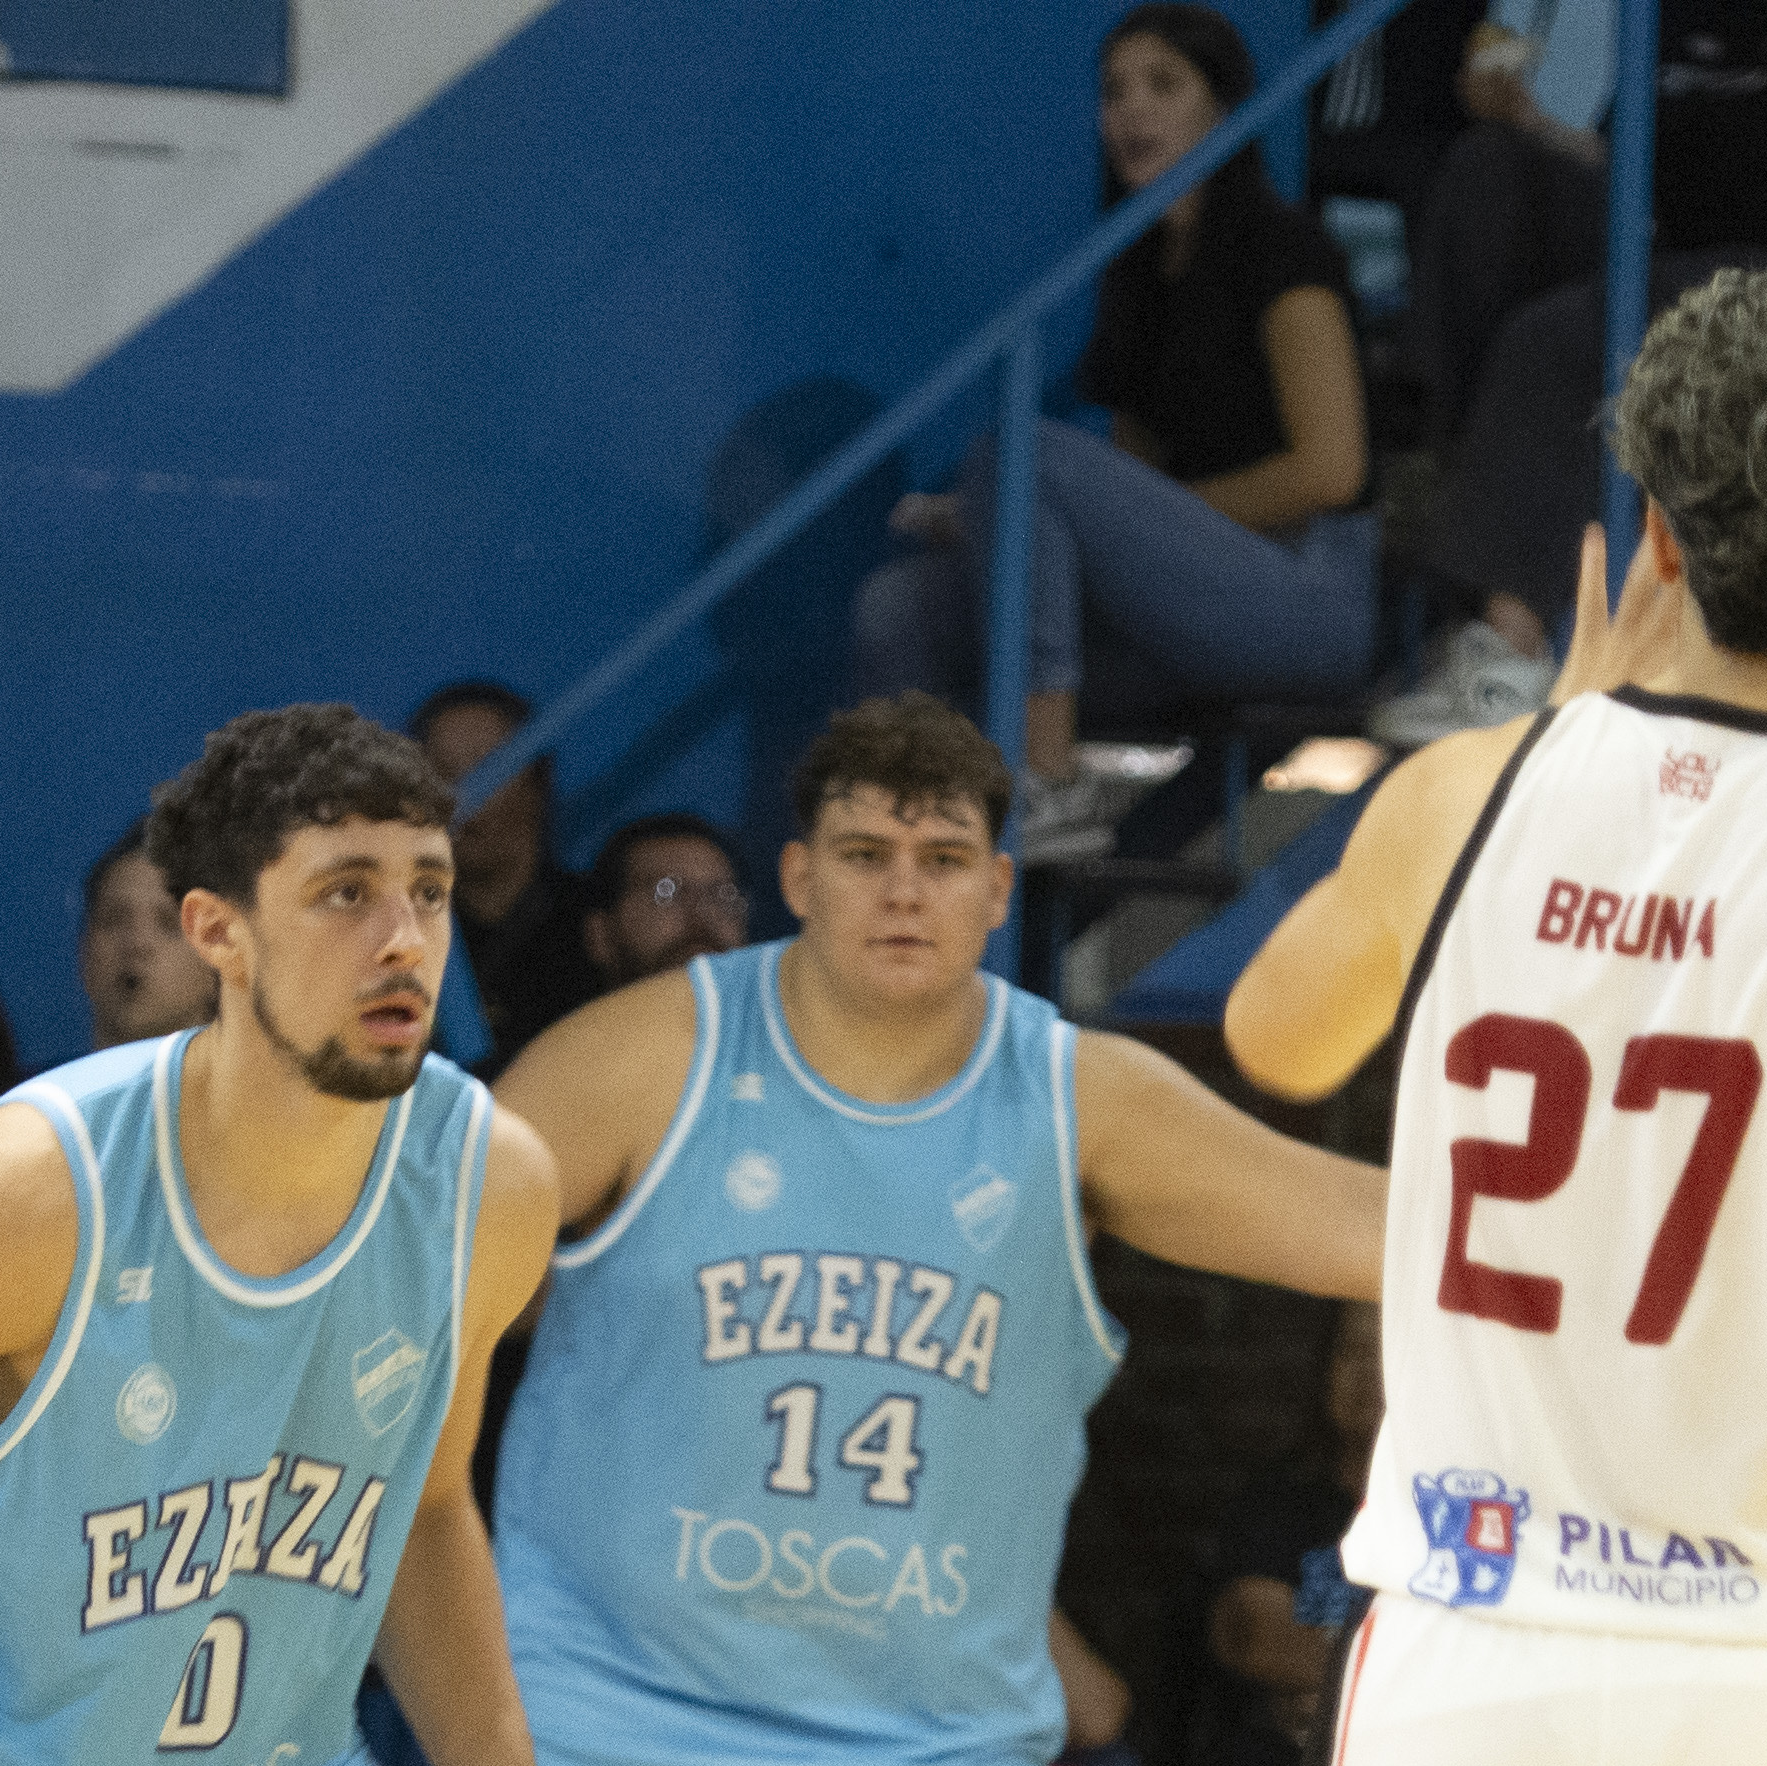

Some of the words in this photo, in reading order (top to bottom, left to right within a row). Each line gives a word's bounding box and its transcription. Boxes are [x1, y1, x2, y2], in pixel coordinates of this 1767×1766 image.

[1436, 1012, 1764, 1346] 27
[696, 1250, 1004, 1396] EZEIZA
[765, 1380, 923, 1507] 14
[671, 1506, 970, 1617] TOSCAS
[1555, 1564, 1760, 1606] MUNICIPIO
[155, 1610, 250, 1752] 0
